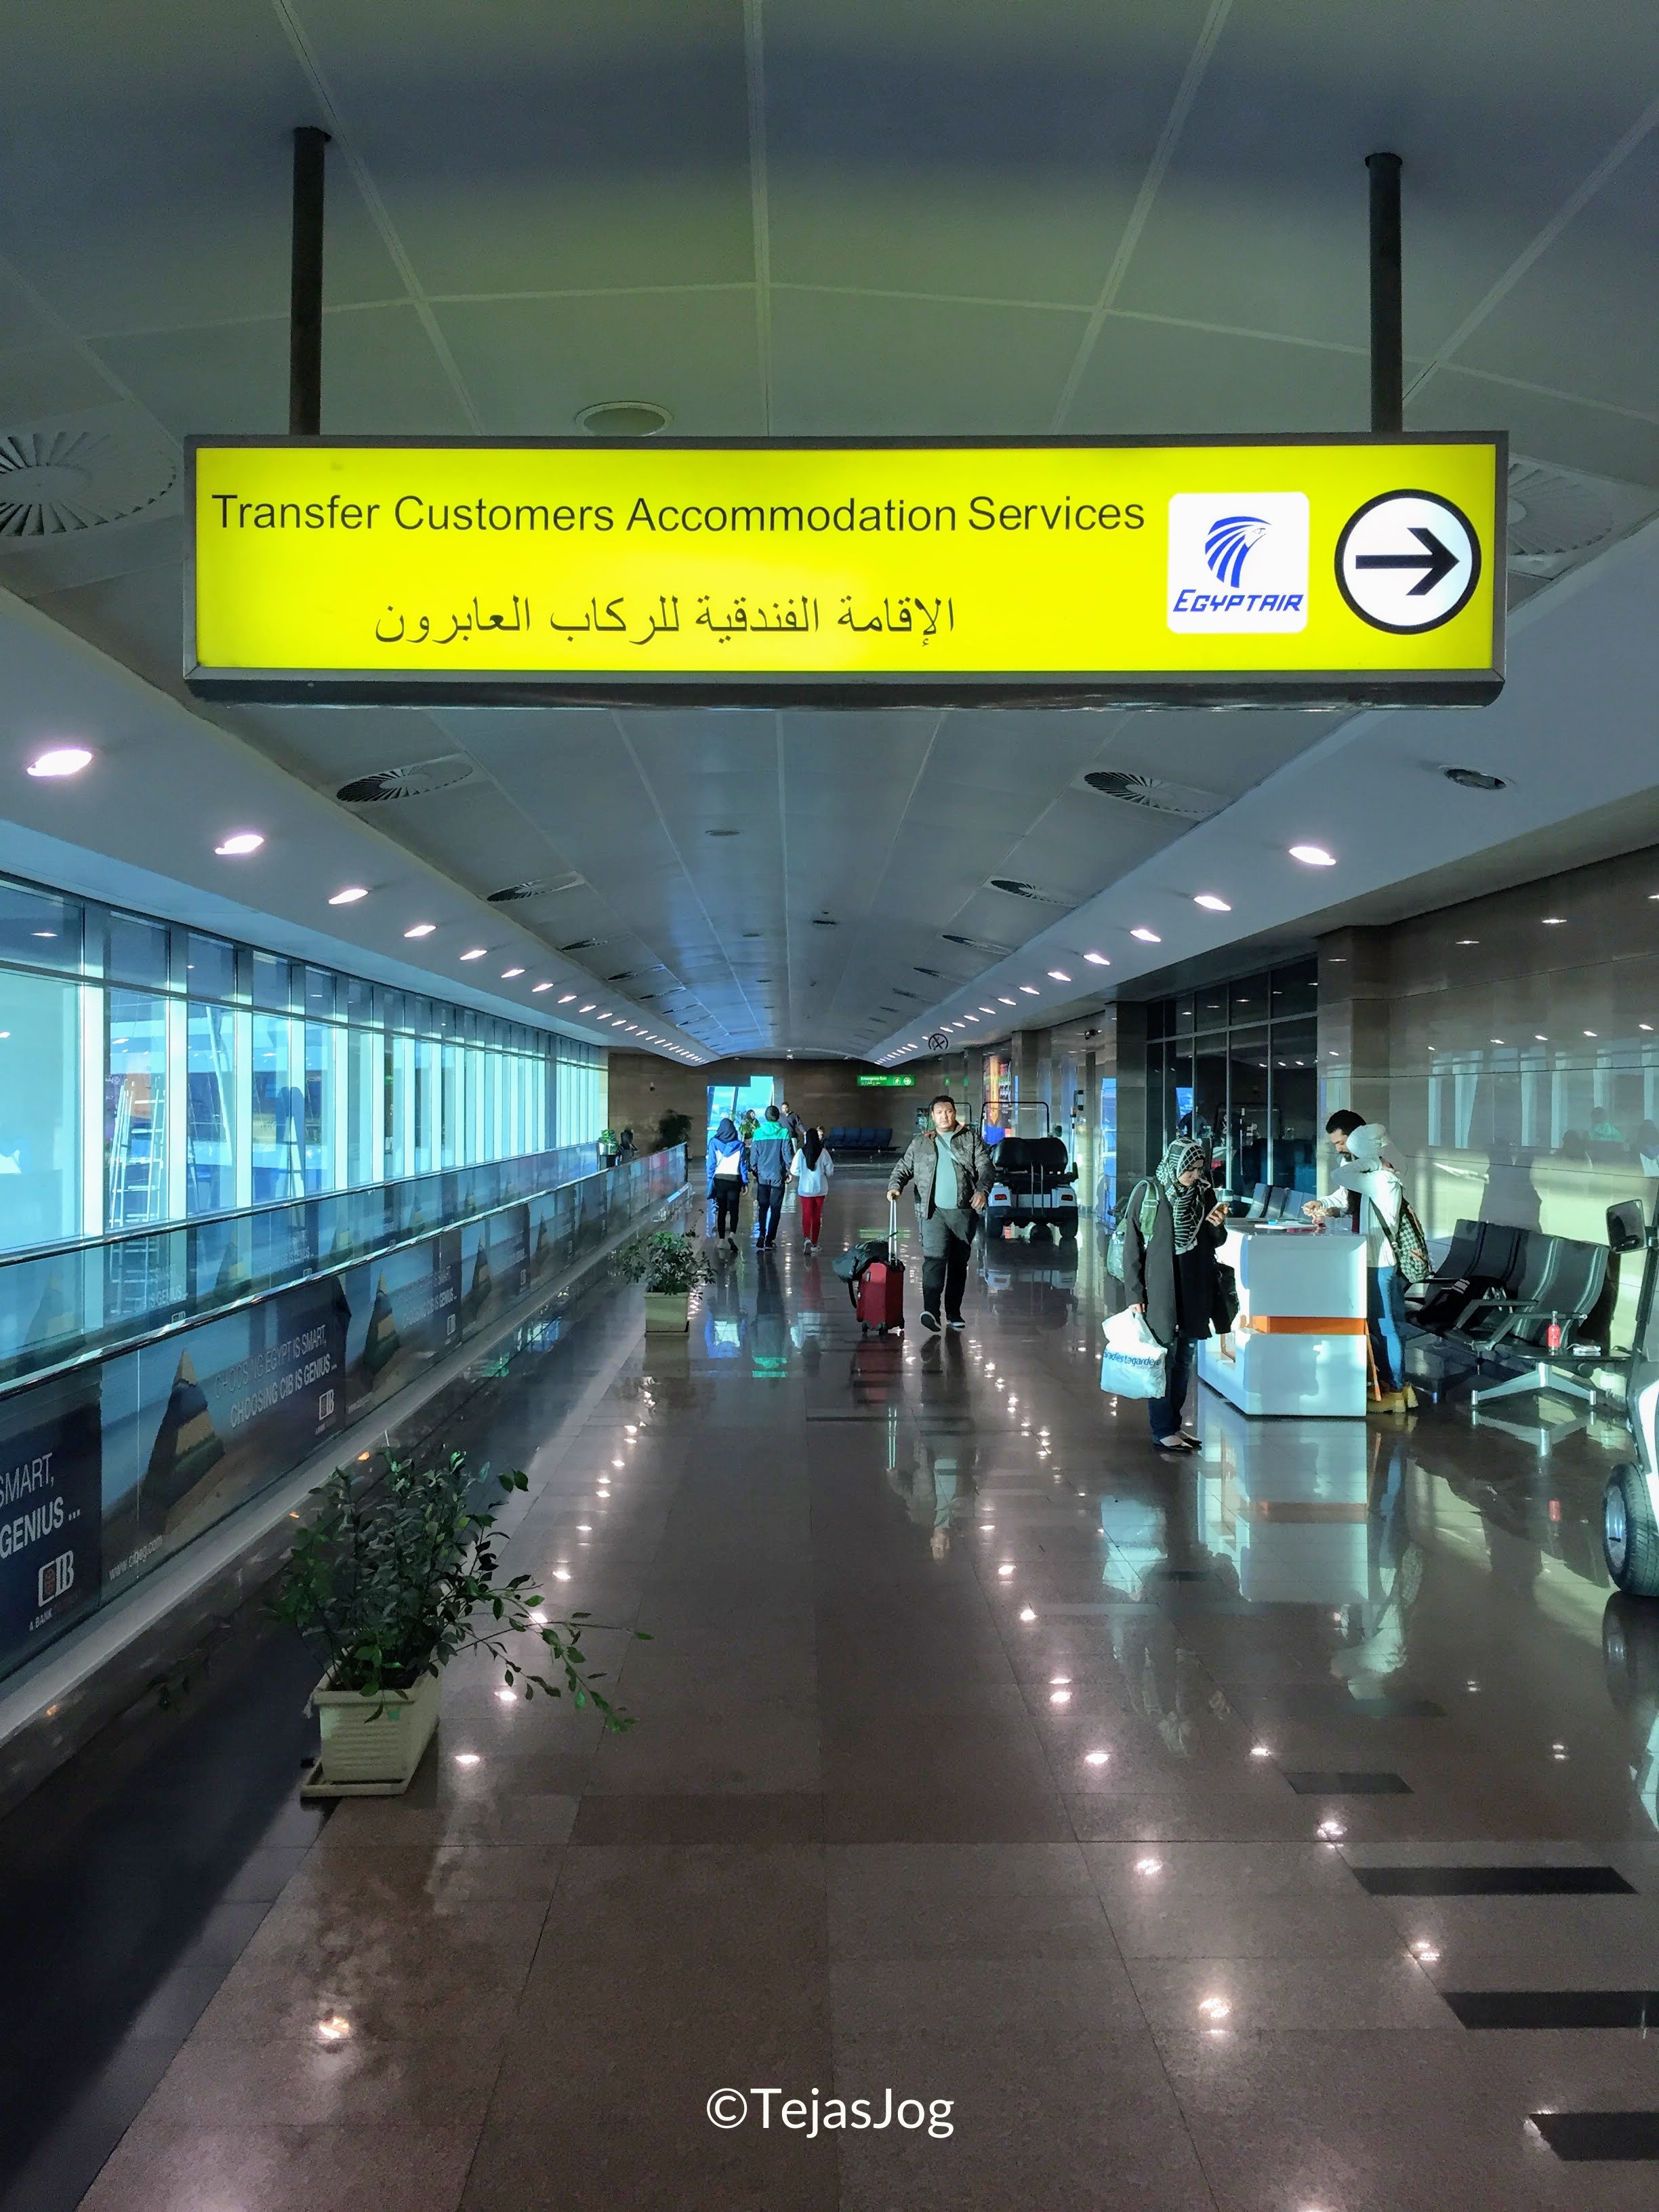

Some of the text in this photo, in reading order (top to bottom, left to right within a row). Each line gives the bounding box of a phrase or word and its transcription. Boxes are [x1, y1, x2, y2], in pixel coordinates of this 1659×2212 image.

[211, 494, 1145, 532] Transfer Customers Accommodation Services
[375, 595, 954, 646] الإقامة الفندقية للركاب العابرون
[1172, 589, 1304, 612] EGYPTAIR
[230, 1382, 278, 1429] CHOOSING
[280, 1373, 293, 1399] CIB
[295, 1368, 303, 1391] IS
